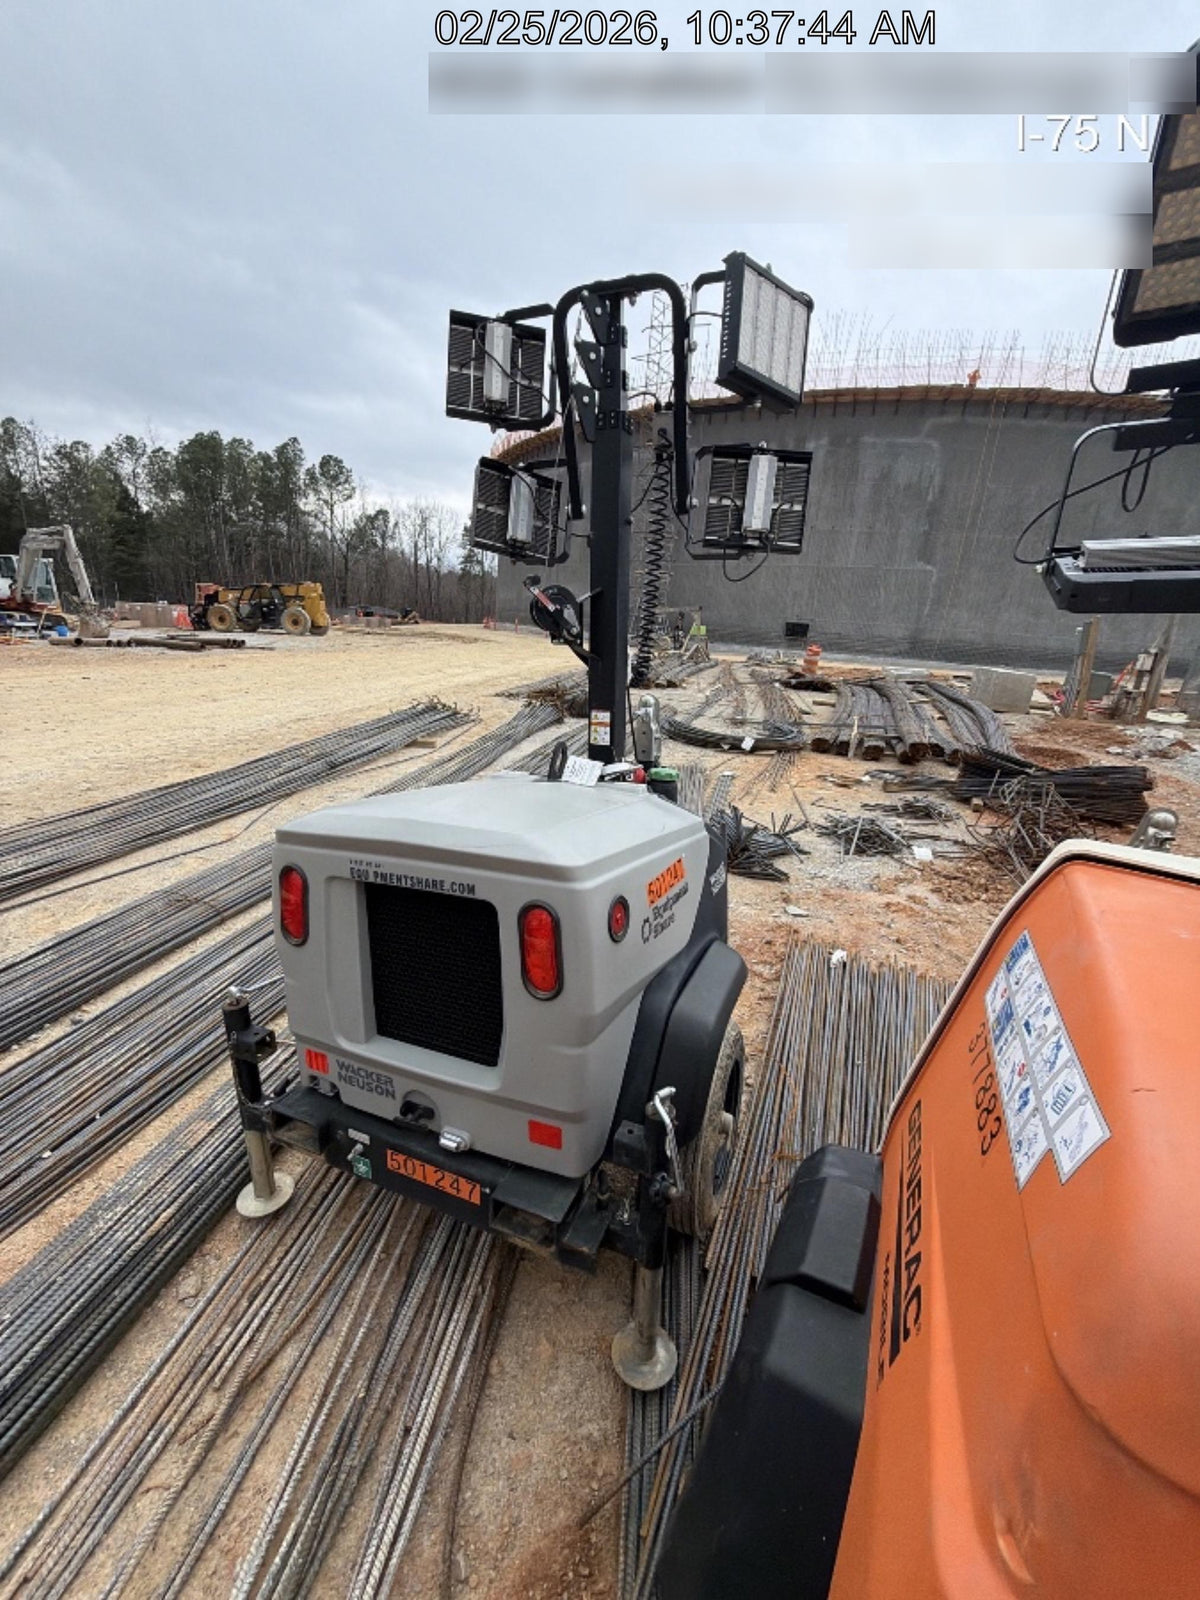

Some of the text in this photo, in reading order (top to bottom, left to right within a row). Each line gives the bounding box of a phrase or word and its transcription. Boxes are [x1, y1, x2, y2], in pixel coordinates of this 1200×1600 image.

[349, 867, 476, 897] EQUPMENTSHARE.COM
[336, 1058, 394, 1089] WACKER
[337, 1071, 396, 1101] NEUSON
[389, 1151, 478, 1201] 501247
[902, 1099, 922, 1344] GENERAC
